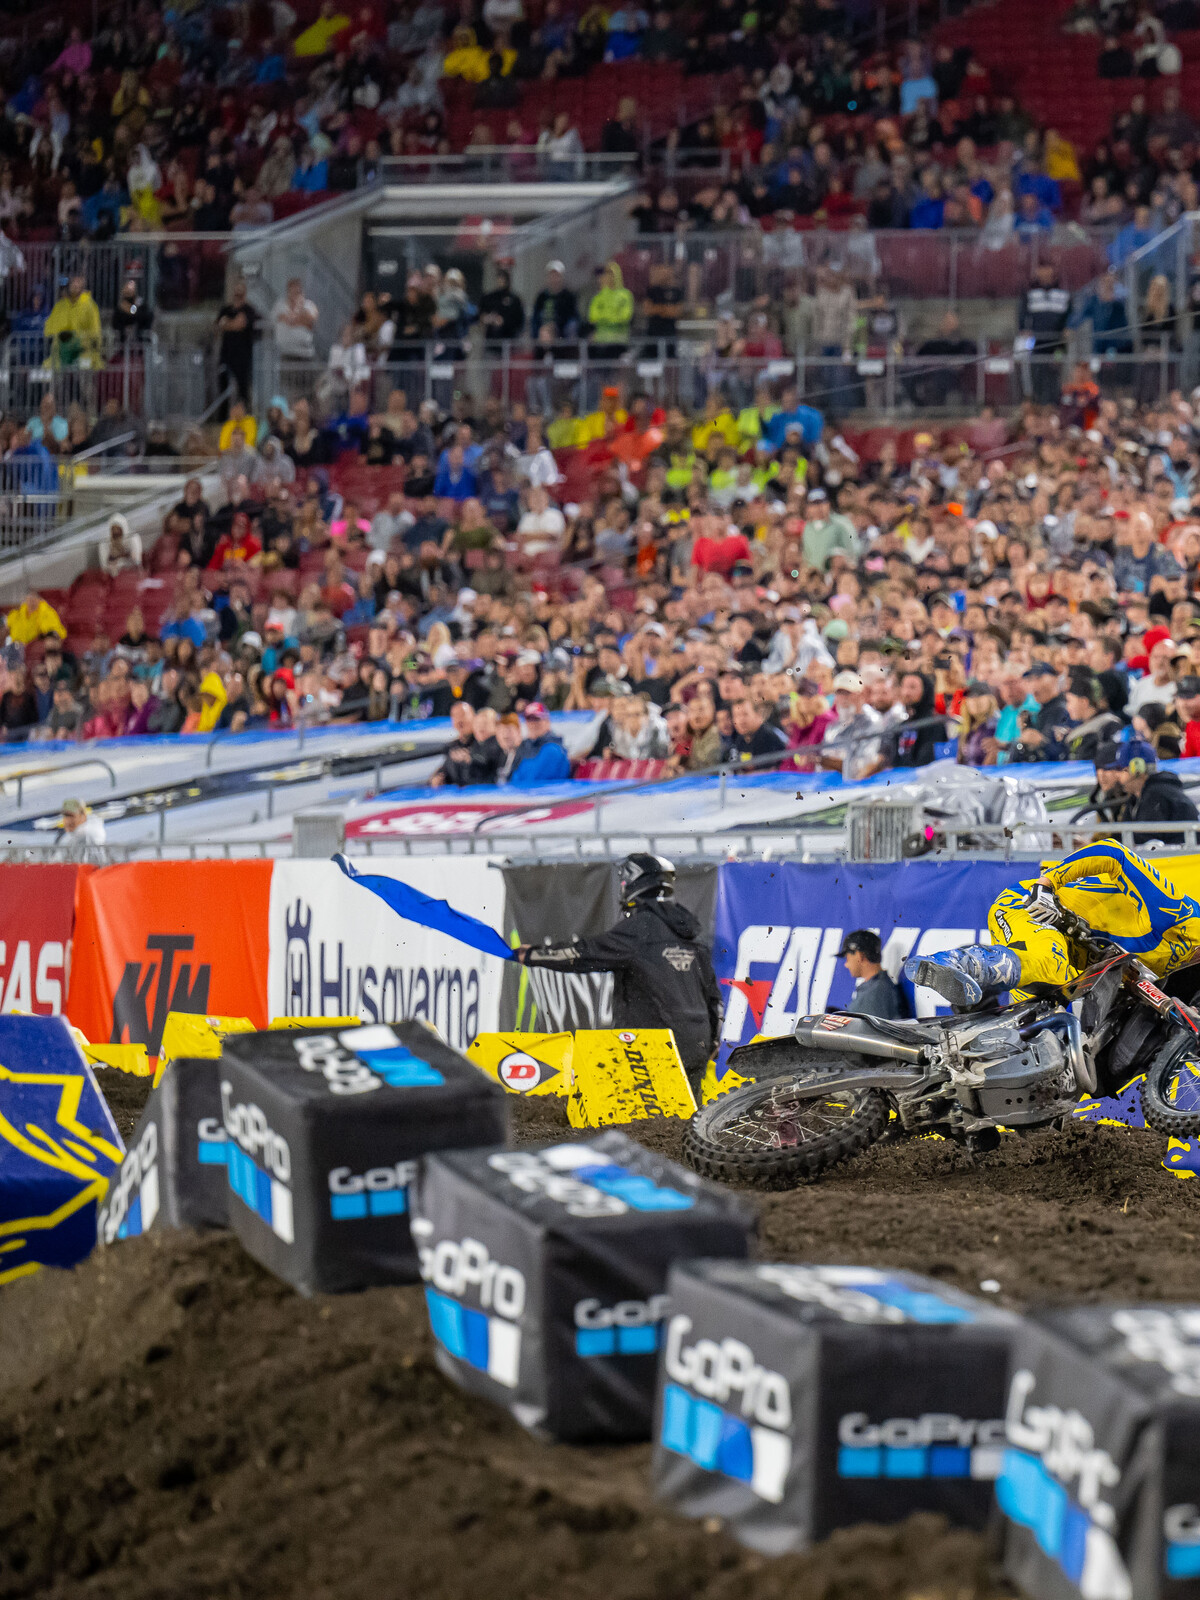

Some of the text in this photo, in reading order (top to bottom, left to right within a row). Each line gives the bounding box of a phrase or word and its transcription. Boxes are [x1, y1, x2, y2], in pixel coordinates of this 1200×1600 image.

[0, 940, 65, 1017] AS
[109, 935, 211, 1056] KTM
[623, 1048, 664, 1119] DUNLO
[666, 1315, 793, 1432] GoPro
